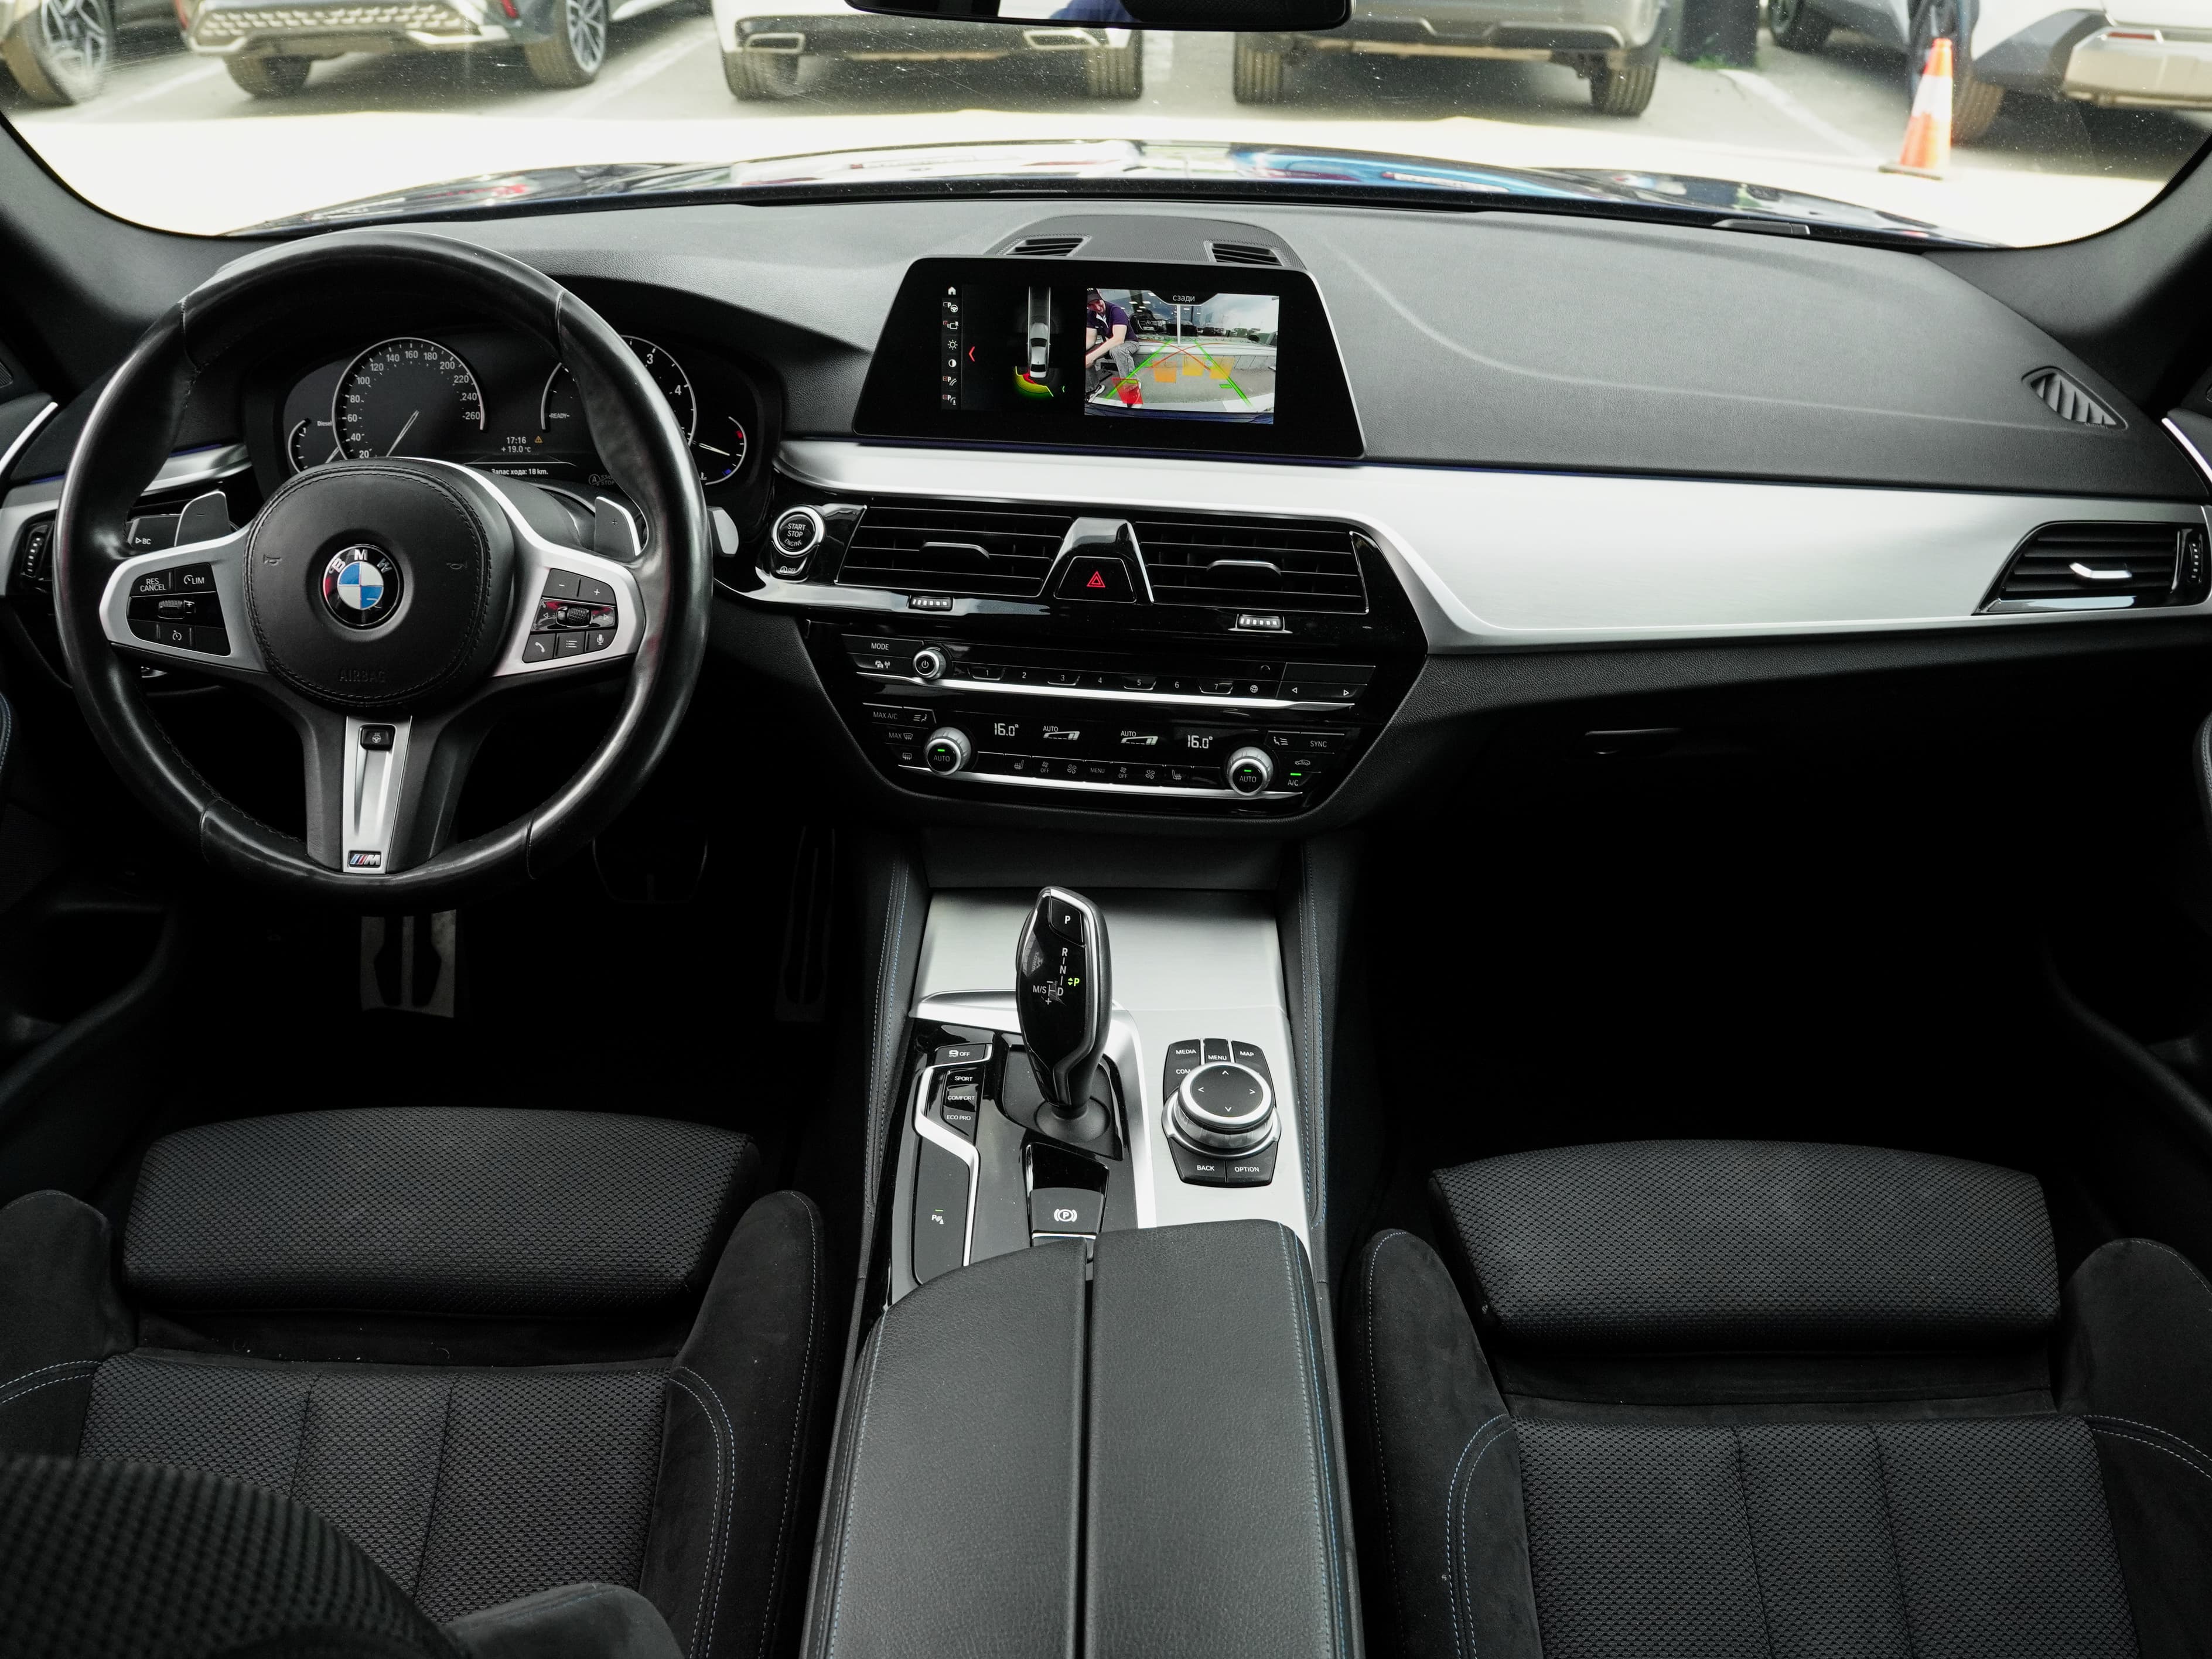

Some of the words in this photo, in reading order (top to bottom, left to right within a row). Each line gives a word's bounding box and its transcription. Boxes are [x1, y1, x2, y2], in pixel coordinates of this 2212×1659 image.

[1172, 294, 1195, 302] сзади
[386, 354, 400, 362] 140
[405, 350, 418, 359] 160
[424, 352, 438, 360] 180
[646, 354, 654, 364] 3
[370, 363, 384, 371] 120
[439, 361, 455, 370] 200
[357, 376, 370, 385] 100
[453, 375, 469, 384] 220
[674, 385, 682, 395] 4
[350, 395, 360, 403] 80
[462, 392, 477, 401] 240
[465, 412, 480, 420] 260
[351, 433, 361, 441] 40
[359, 450, 369, 458] 20
[787, 523, 806, 531] START
[784, 538, 803, 547] ENGINE
[332, 548, 392, 574] BMW
[140, 583, 166, 592] CANCEL
[1064, 916, 1071, 924] P
[1062, 947, 1068, 957] R
[1060, 965, 1066, 974] N
[1074, 978, 1080, 986] P
[1033, 985, 1047, 994] M/S
[1057, 987, 1064, 996] D
